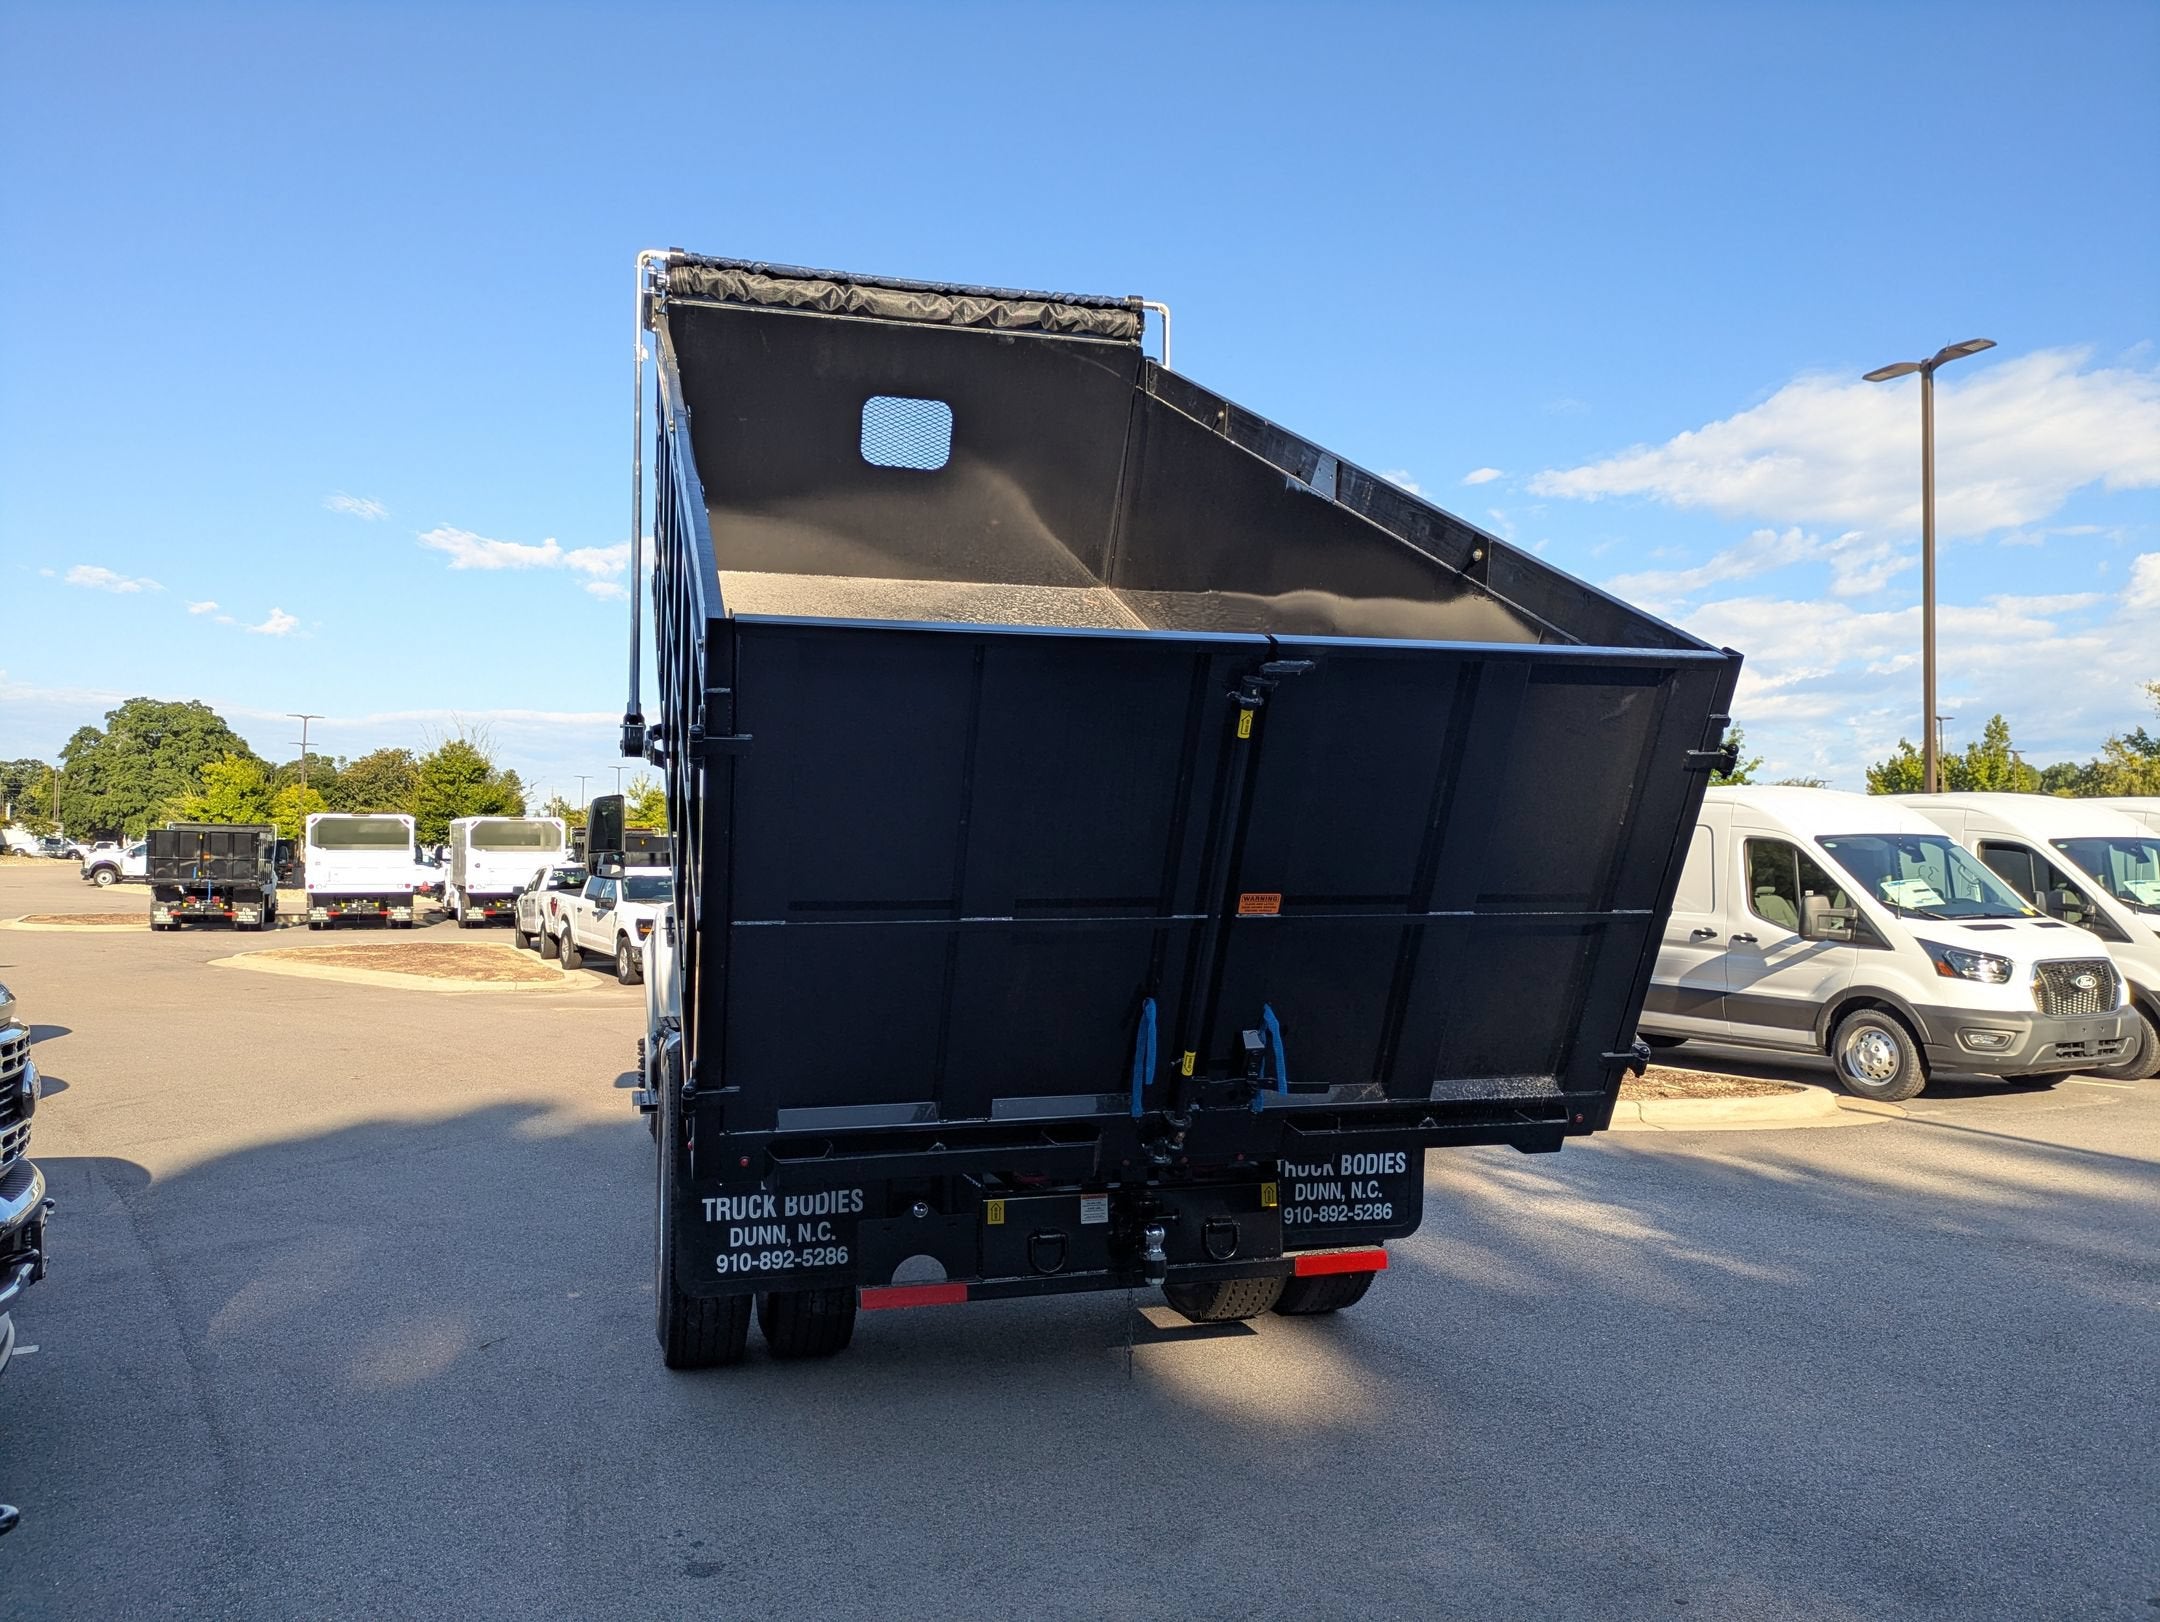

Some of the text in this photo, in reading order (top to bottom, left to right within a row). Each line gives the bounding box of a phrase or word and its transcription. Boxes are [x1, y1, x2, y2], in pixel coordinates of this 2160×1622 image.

[1340, 1151, 1406, 1176] BODIES
[1295, 1181, 1345, 1202] DUNN,
[1350, 1180, 1382, 1199] N.C.
[702, 1188, 864, 1222] TRUCK BODIES
[1284, 1202, 1393, 1224] 910-892-5286
[729, 1221, 836, 1248] DUNN, N.C.
[716, 1246, 849, 1273] 910-892-5286
